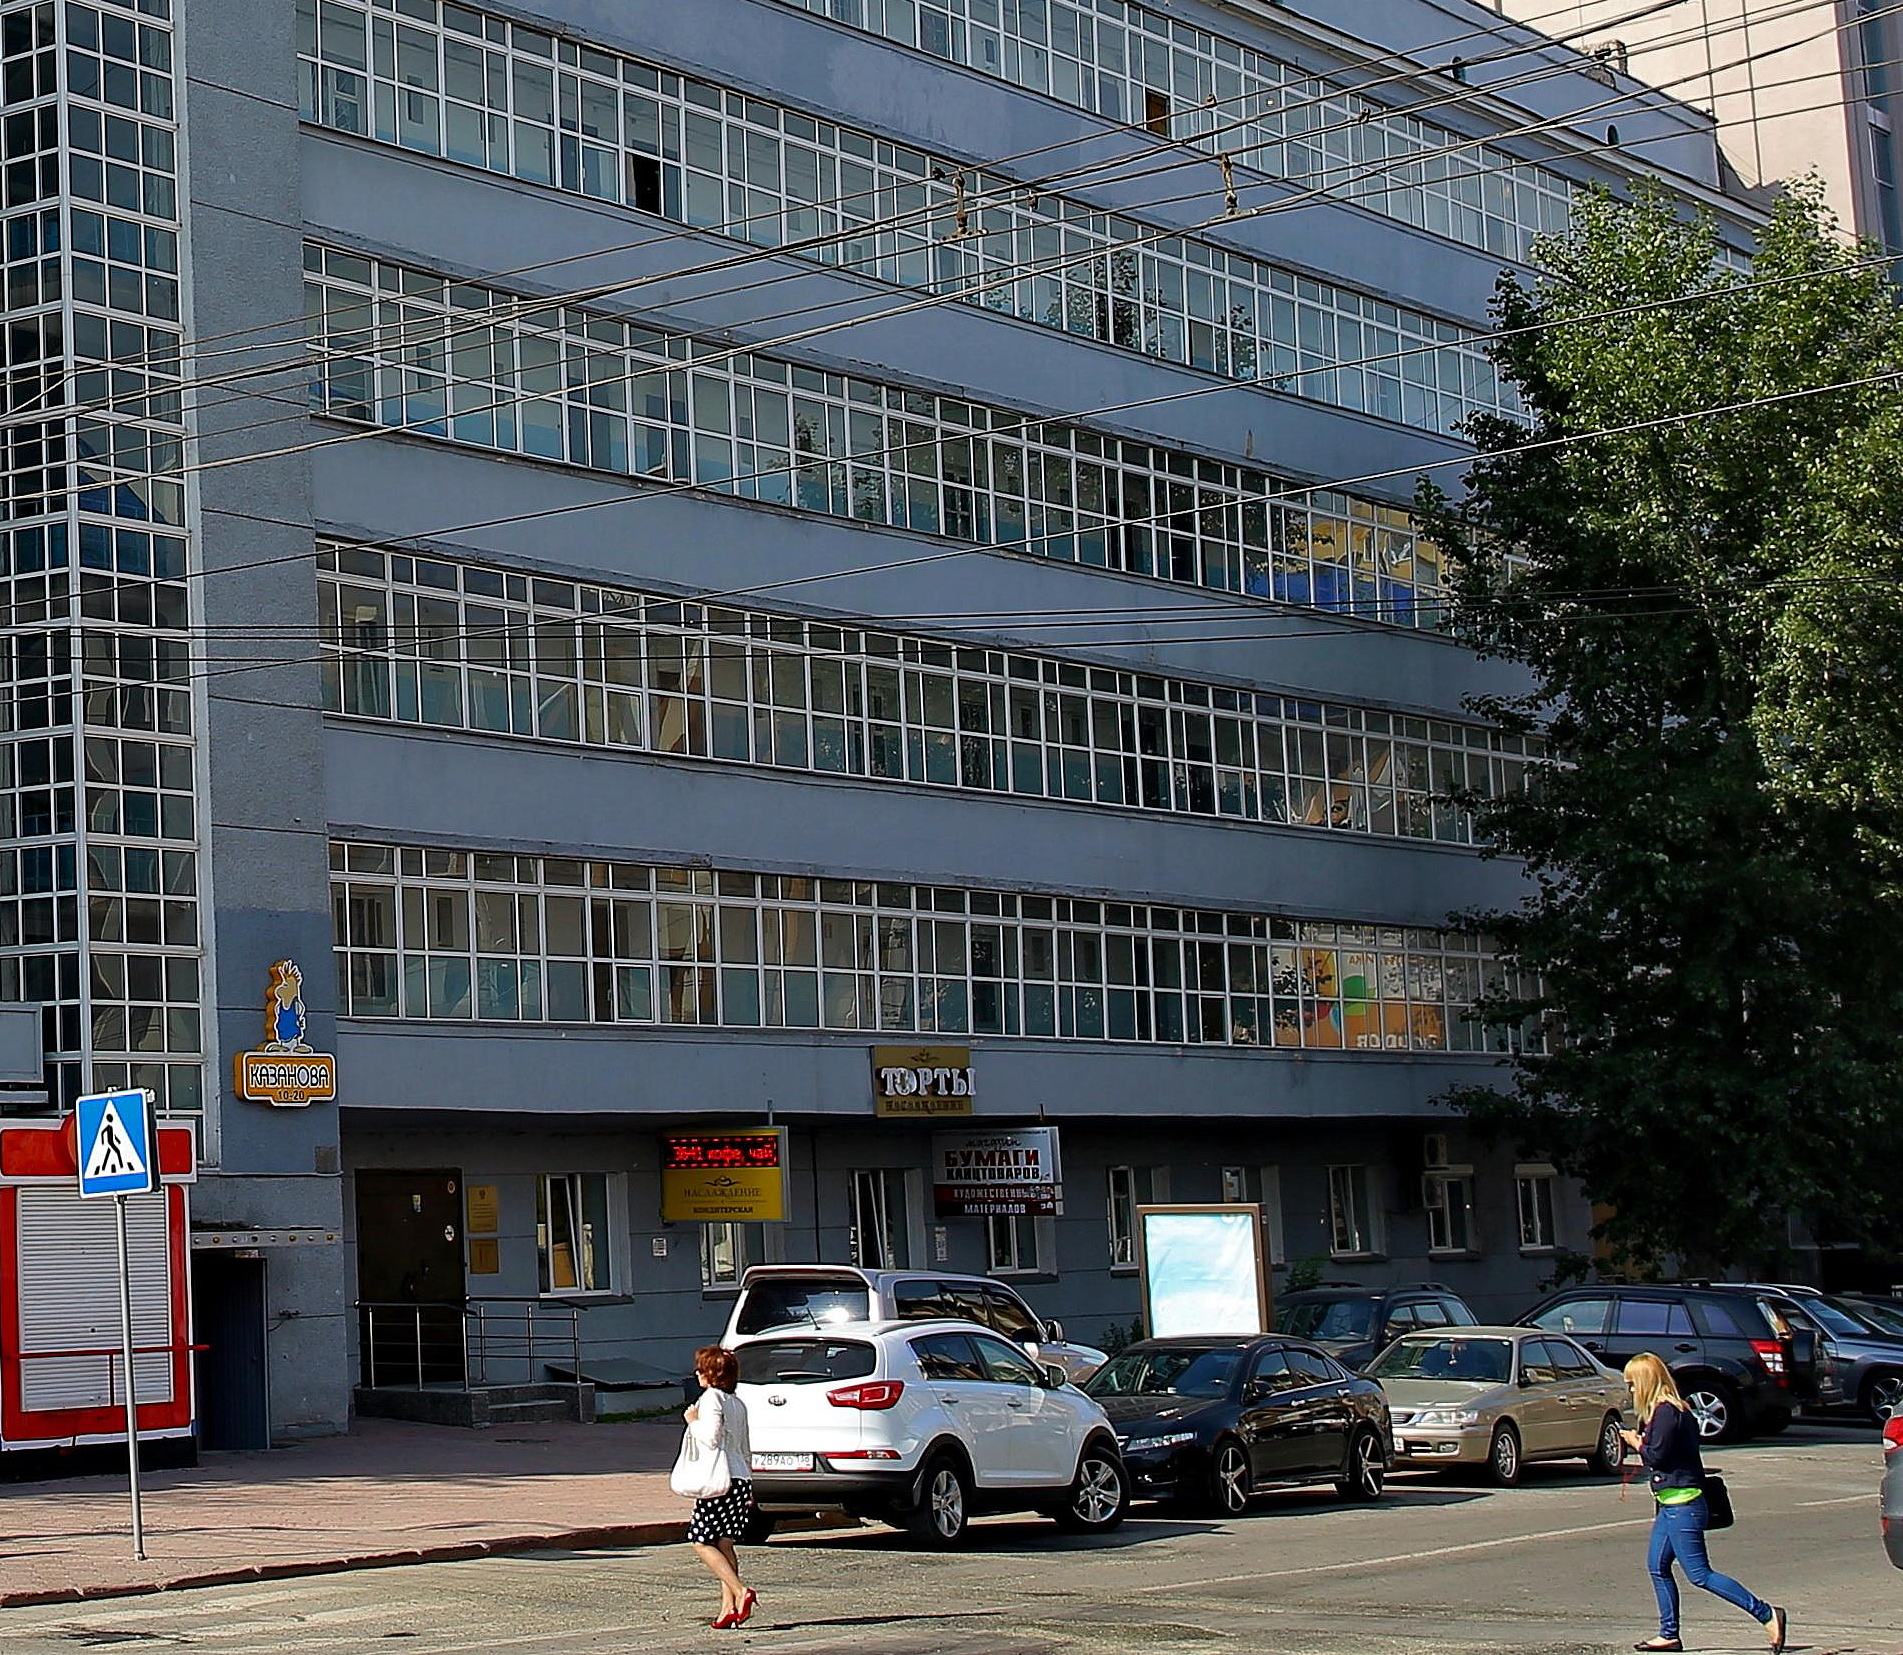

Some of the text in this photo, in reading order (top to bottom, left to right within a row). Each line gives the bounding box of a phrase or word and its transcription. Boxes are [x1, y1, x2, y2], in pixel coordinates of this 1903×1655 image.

[250, 1065, 329, 1087] КАЗАНОВА
[881, 1067, 977, 1096] ТОРТЫ
[278, 1090, 305, 1100] 10-20
[944, 1149, 1040, 1167] БУМАГИ
